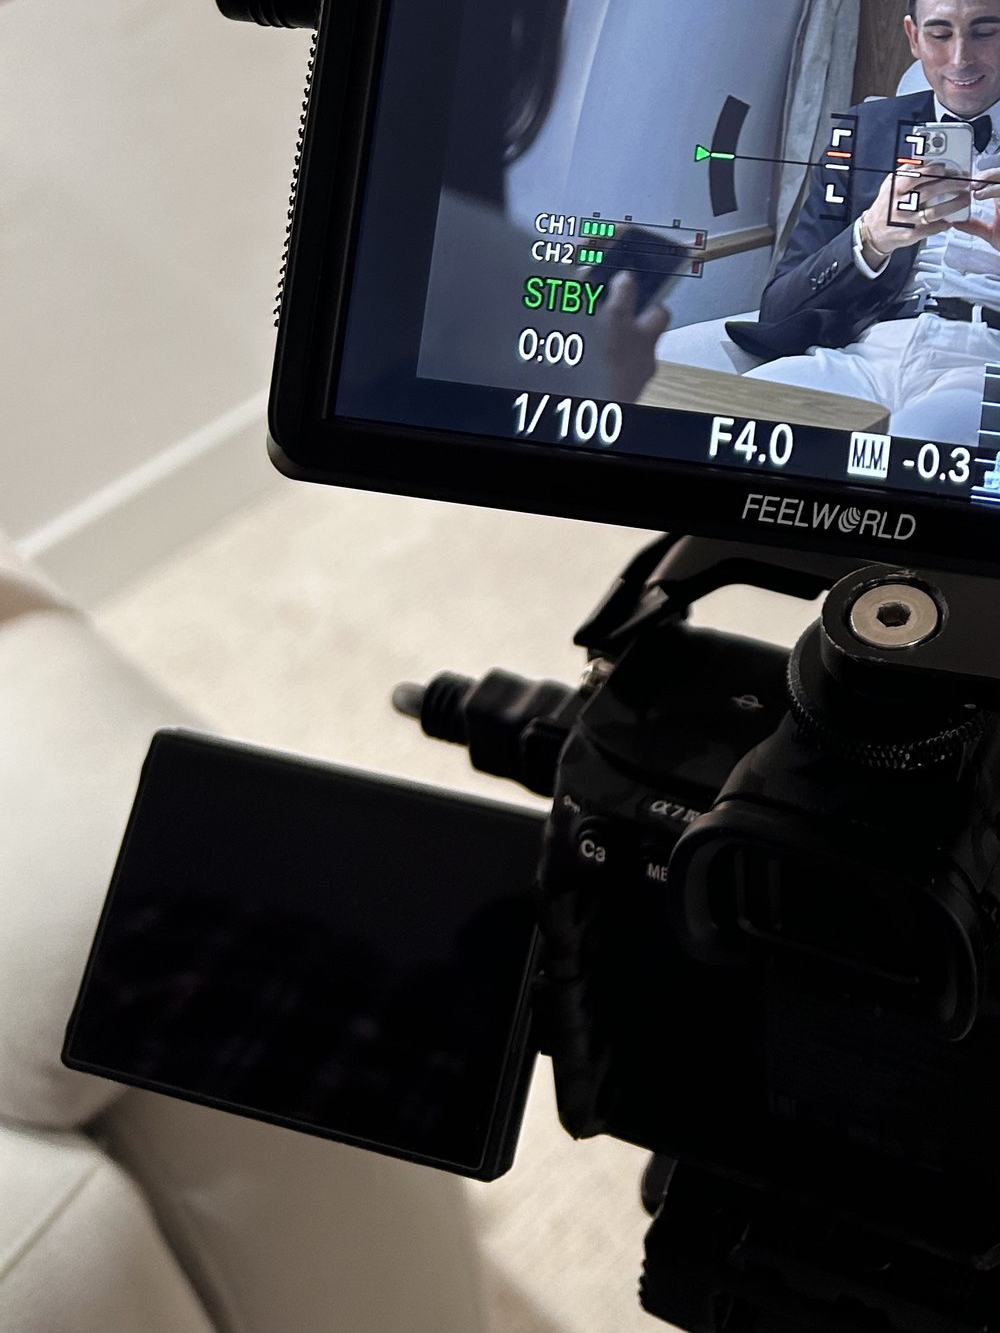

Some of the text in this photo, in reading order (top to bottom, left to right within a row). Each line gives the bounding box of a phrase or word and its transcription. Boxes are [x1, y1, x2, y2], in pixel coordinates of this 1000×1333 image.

[534, 213, 576, 237] CH1
[531, 241, 573, 265] CH2
[523, 276, 603, 315] STBY
[518, 328, 583, 366] 0:00
[514, 392, 623, 445] 1/100
[709, 417, 794, 465] F4.0
[903, 443, 970, 483] -0.3
[741, 493, 917, 541] FEELWORLD
[647, 861, 669, 882] ME
